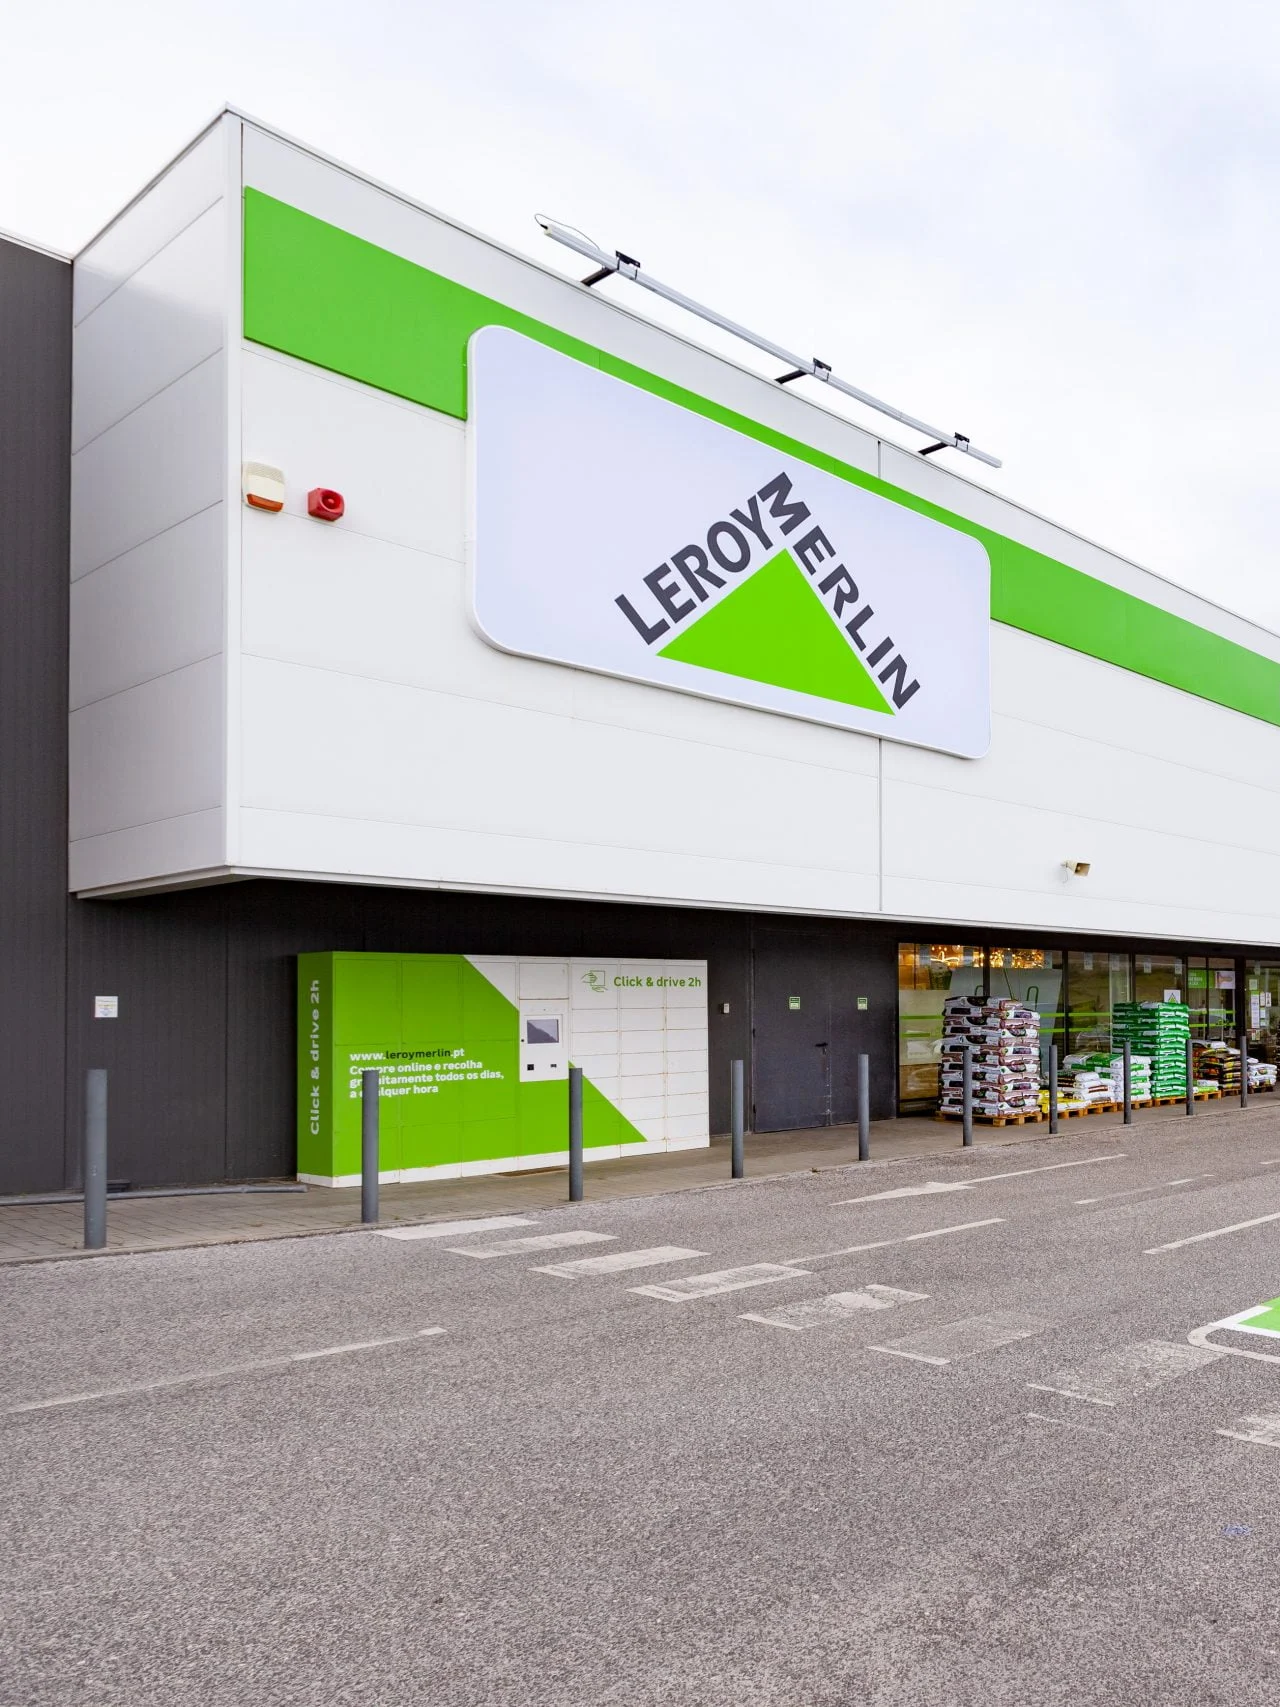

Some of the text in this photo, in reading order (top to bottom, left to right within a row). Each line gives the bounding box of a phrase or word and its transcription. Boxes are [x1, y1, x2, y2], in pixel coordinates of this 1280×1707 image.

[613, 471, 921, 710] LEROY MERLIN
[613, 975, 702, 987] Click & drive 2h
[310, 979, 320, 1135] Click & drive 2h
[349, 1048, 465, 1061] www.leroymerlin.pt
[397, 1062, 433, 1073] online
[433, 1063, 442, 1071] e
[443, 1060, 483, 1071] recolha
[349, 1070, 505, 1089] gritamente todos os dias,
[349, 1084, 439, 1098] a lquer hora
